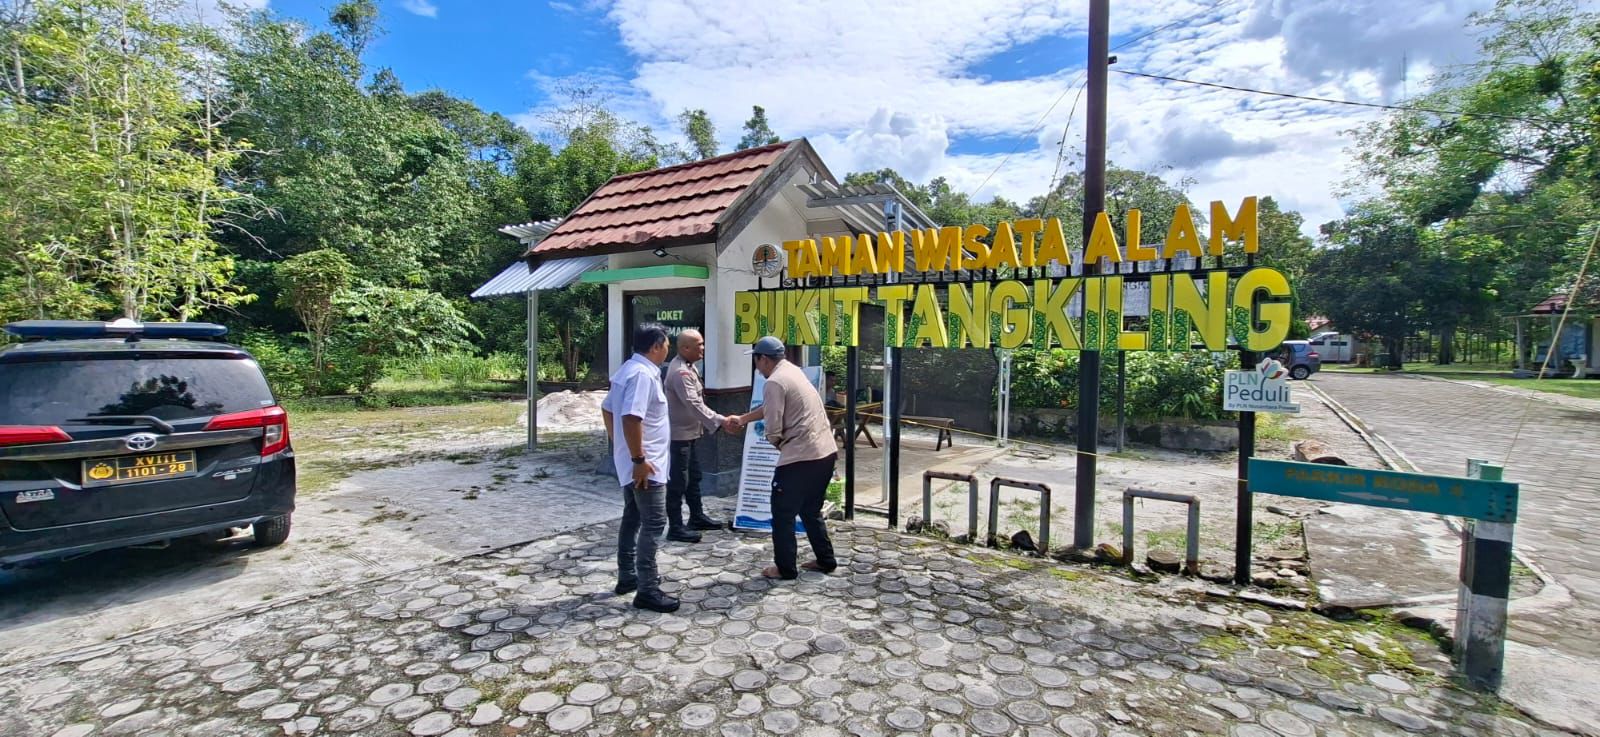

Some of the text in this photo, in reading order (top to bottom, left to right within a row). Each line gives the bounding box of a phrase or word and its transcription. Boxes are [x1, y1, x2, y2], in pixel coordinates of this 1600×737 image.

[782, 196, 1259, 279] TAMAN WISATA ALAM
[657, 310, 683, 321] LOKET
[735, 268, 1296, 352] BUKIT TANGKILING
[1228, 373, 1258, 385] PLN
[1228, 383, 1289, 402] Peduli
[136, 454, 177, 466] XVIII
[1284, 468, 1365, 487] PARKIR
[1373, 476, 1440, 496] RODA
